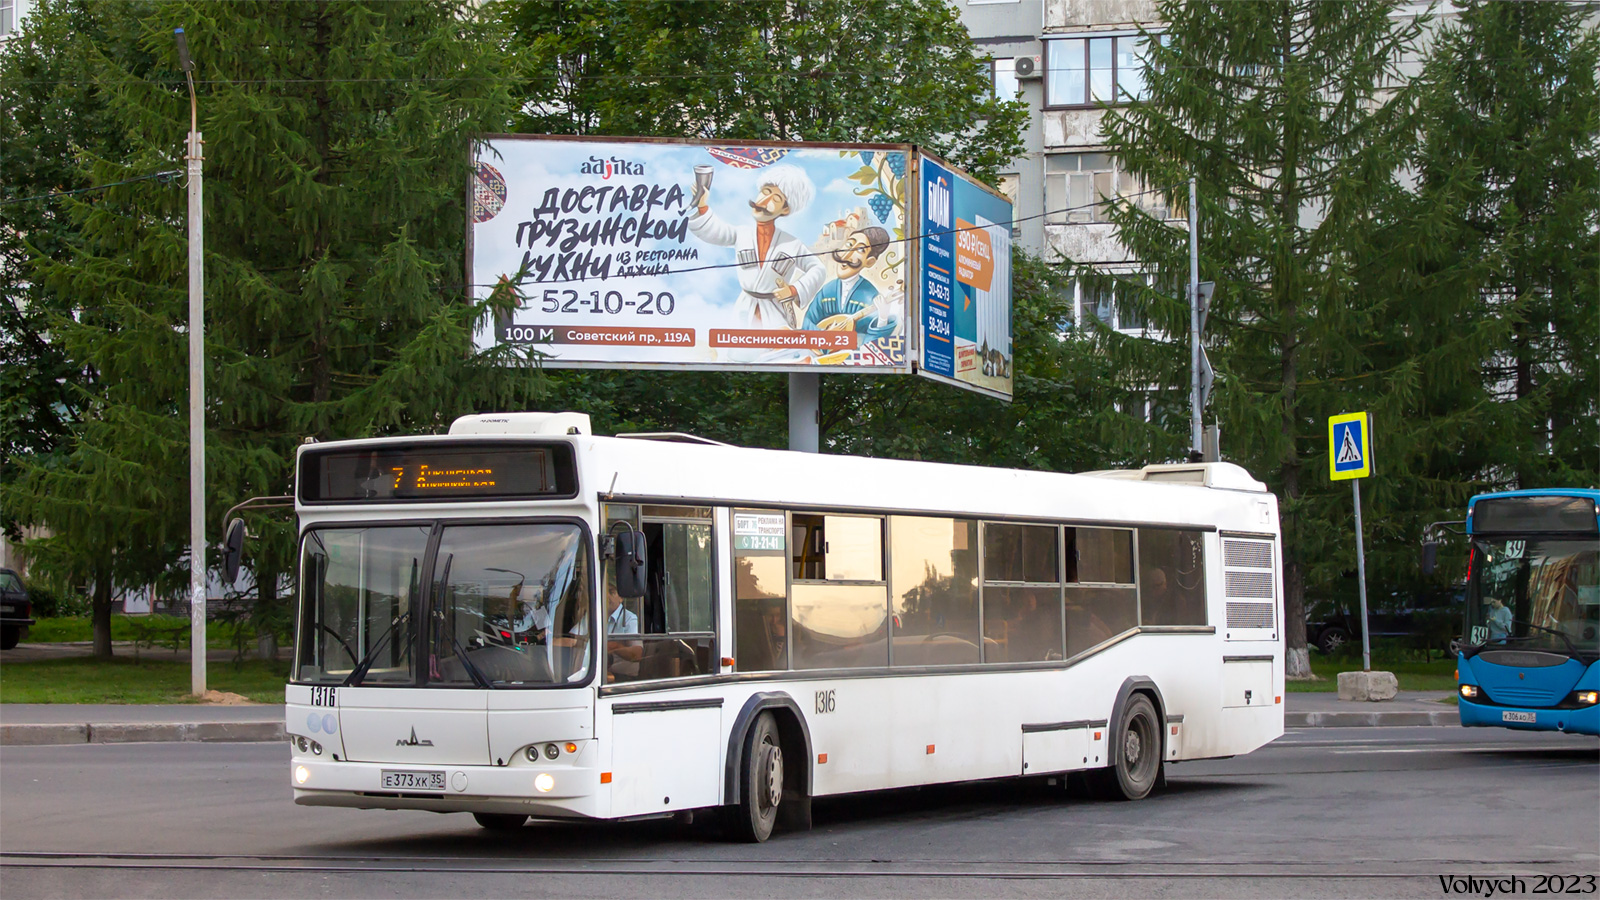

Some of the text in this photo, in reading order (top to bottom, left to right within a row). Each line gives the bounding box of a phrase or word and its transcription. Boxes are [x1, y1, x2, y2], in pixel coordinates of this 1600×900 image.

[581, 156, 644, 179] adjika
[533, 184, 685, 220] ДОСТАВКА
[516, 209, 689, 253] ГРУЗИНСКОЙ
[958, 227, 971, 251] 390
[518, 248, 699, 283] КУХНИ ИЗ РЕСТОРАНА
[617, 263, 670, 278] АДЖИКА
[928, 280, 950, 301] 50-62-73
[542, 290, 675, 315] 52-10-20
[505, 328, 534, 341] 100
[928, 316, 950, 336] 58-20-14
[567, 330, 691, 344] Советский пр., 119А
[717, 333, 849, 347] Шекснинский пр., 23
[392, 467, 403, 488] 7
[751, 536, 778, 549] 73-21-41
[1505, 541, 1524, 559] 39
[1471, 626, 1487, 646] 39
[310, 686, 336, 707] 1316
[815, 690, 836, 714] 1316
[431, 774, 441, 784] 35
